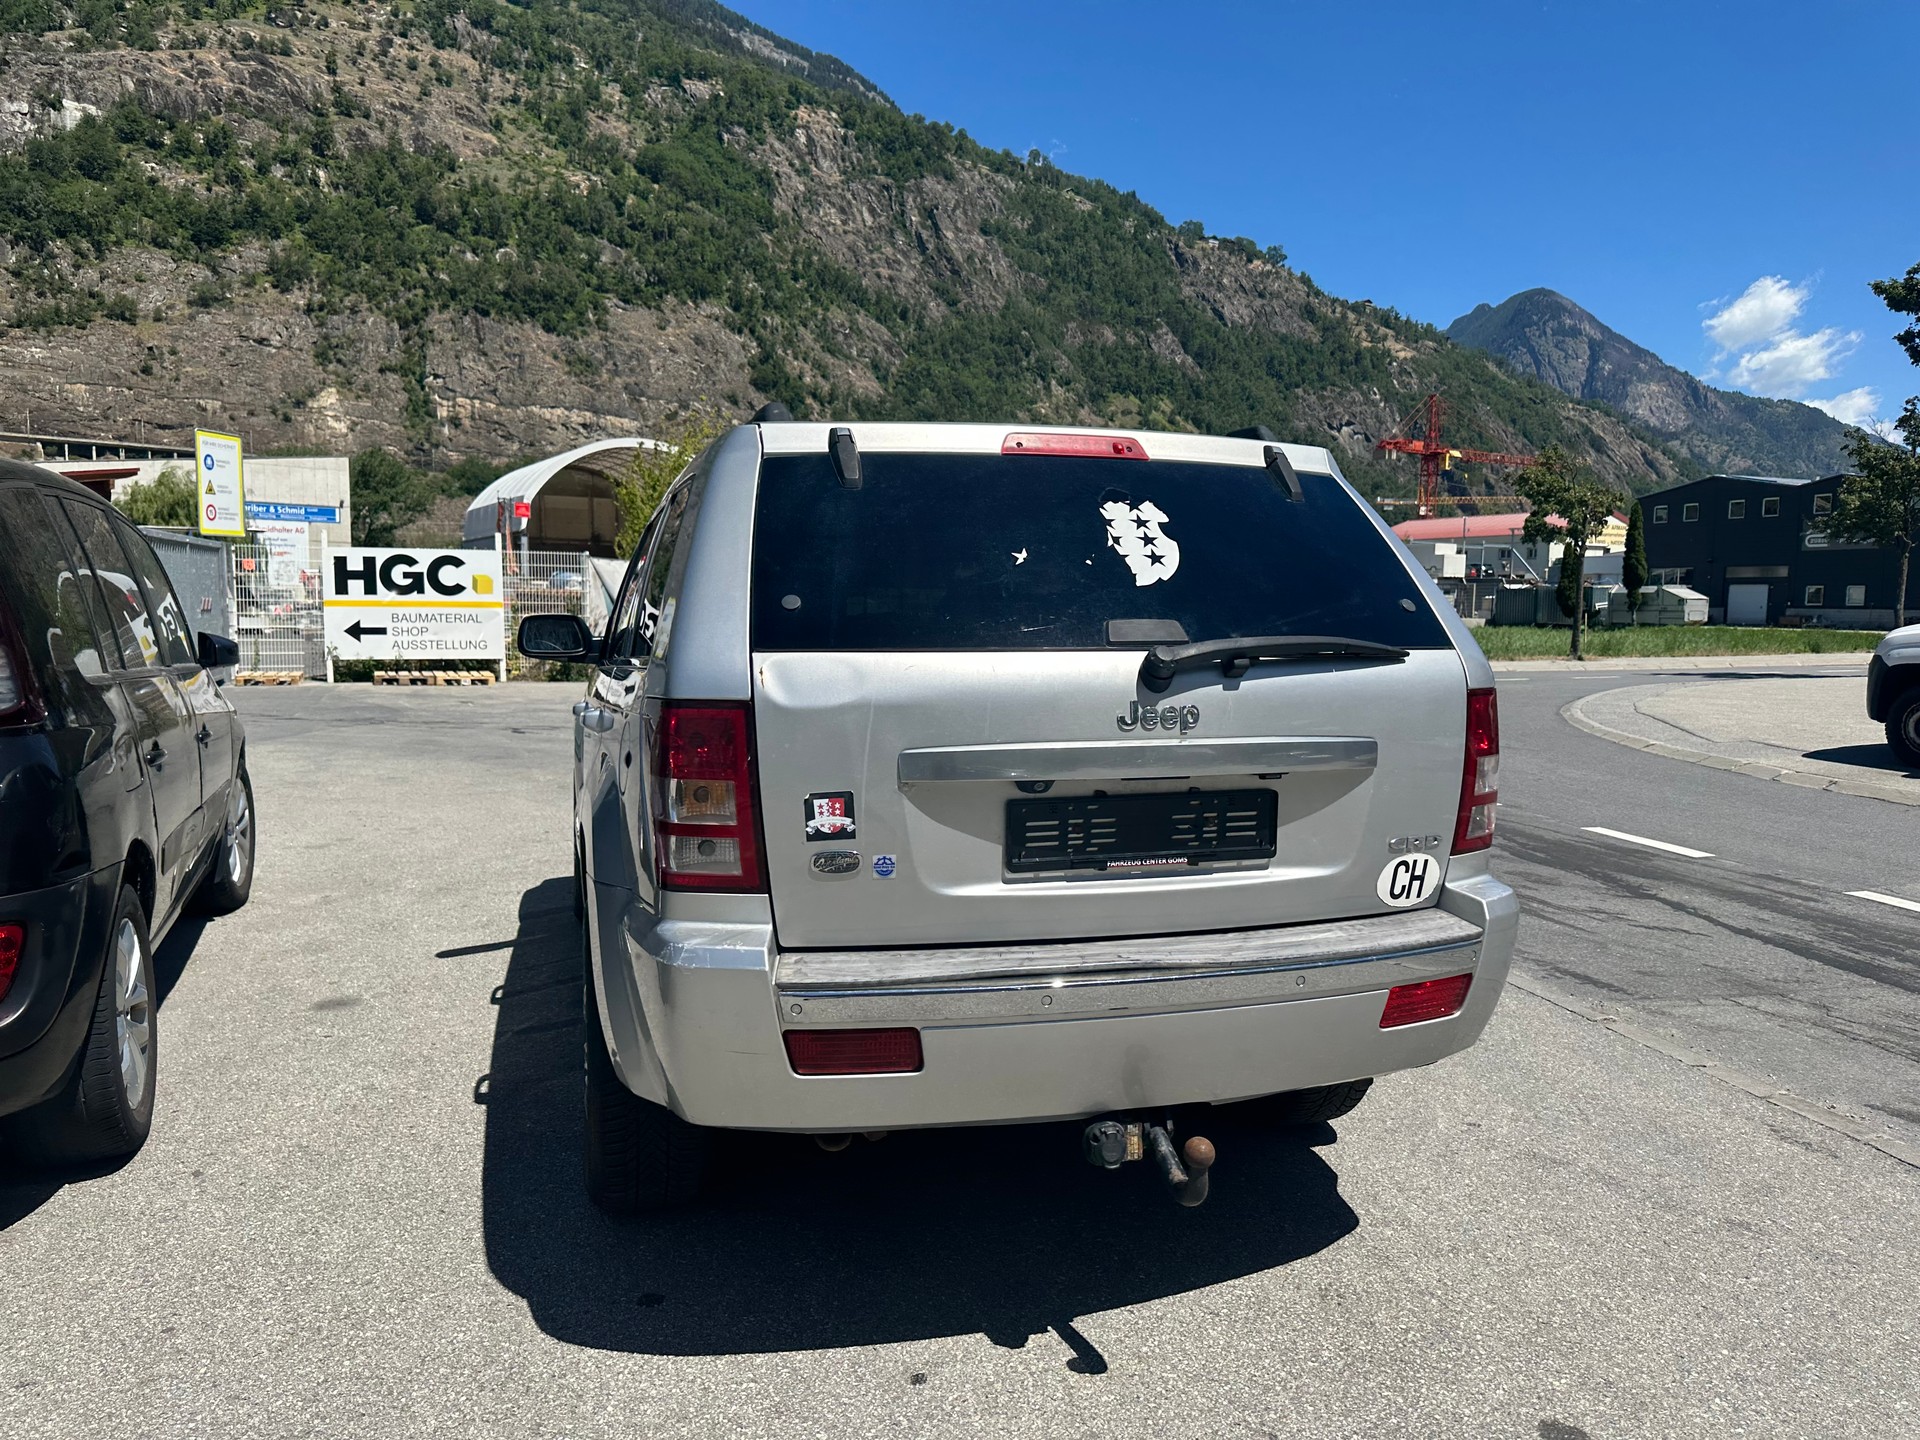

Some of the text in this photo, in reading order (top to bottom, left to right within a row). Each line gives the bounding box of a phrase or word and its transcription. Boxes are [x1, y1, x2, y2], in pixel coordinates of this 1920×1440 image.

[277, 506, 305, 515] Schmid
[333, 554, 467, 596] HGC
[391, 613, 482, 624] BAUMATERIAL
[391, 626, 429, 637] SHOP
[391, 640, 488, 650] AUSSTELLUNG
[1117, 700, 1200, 735] Jeep
[1388, 835, 1441, 852] CRD
[1389, 859, 1429, 900] CH
